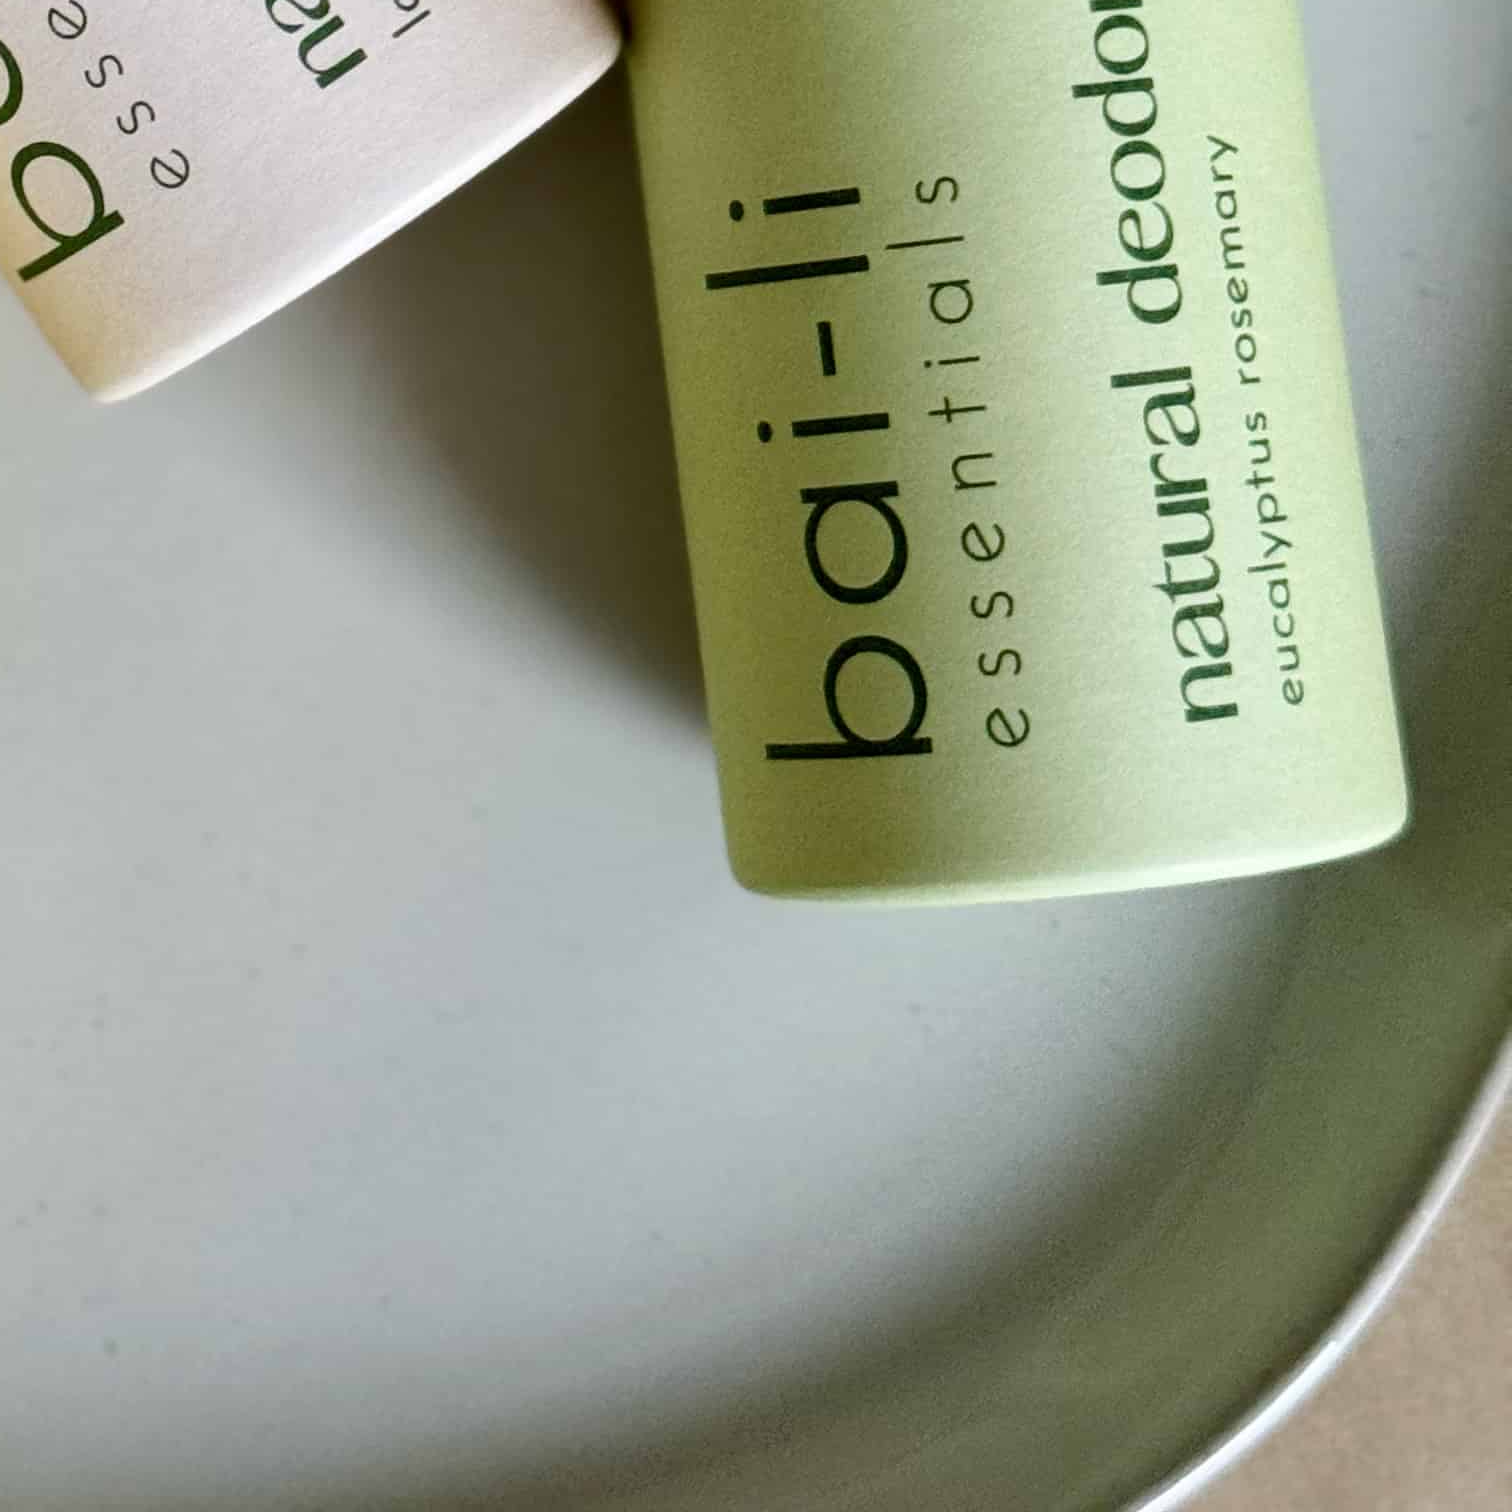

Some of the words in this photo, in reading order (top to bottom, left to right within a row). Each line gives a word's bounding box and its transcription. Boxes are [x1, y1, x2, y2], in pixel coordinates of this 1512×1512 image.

[1206, 133, 1259, 387] rosemary
[706, 187, 934, 761] bai-li
[885, 173, 1031, 749] essentials
[1110, 365, 1239, 723] natural
[1247, 412, 1305, 706] eucalyptus
